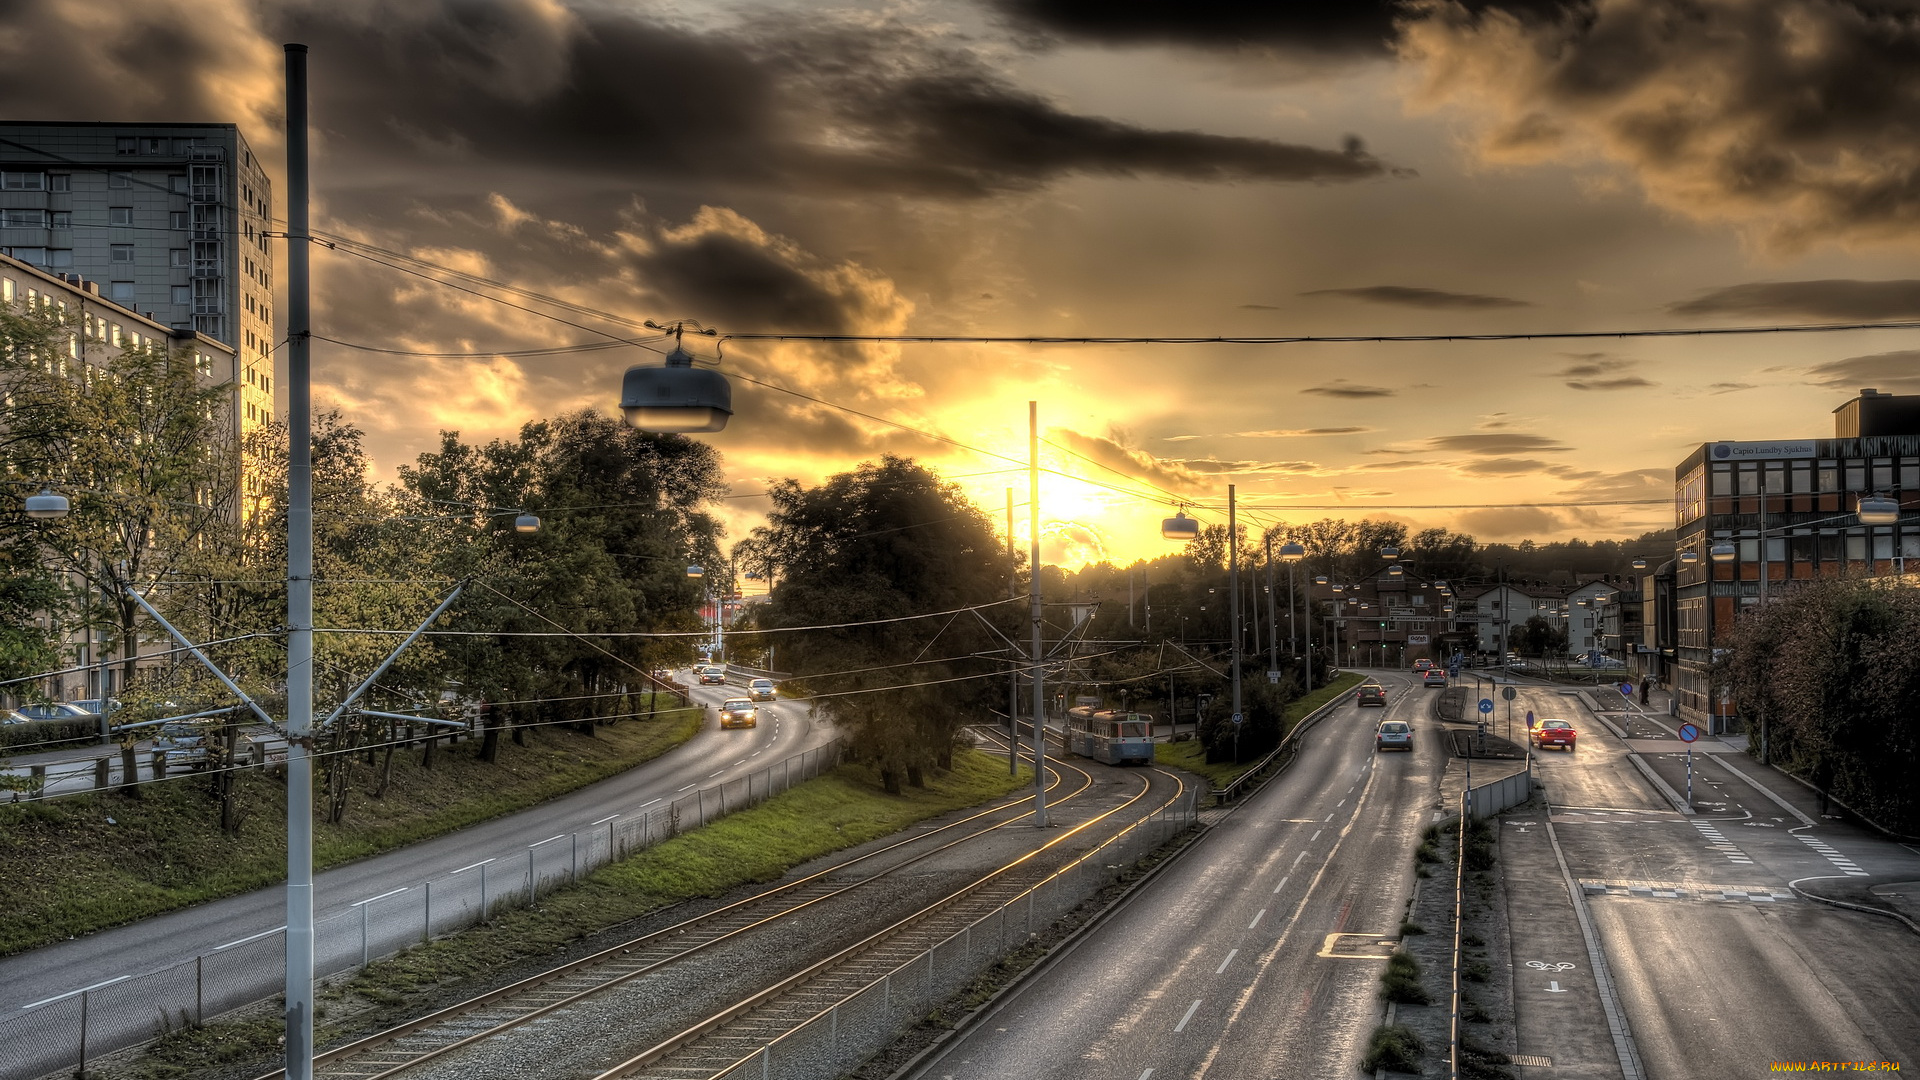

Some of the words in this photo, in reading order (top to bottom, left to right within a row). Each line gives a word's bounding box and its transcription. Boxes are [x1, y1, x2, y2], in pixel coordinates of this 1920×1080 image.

[1733, 448, 1754, 456] Capio
[1756, 447, 1782, 455] Lundby
[1784, 446, 1812, 454] Sjukhus
